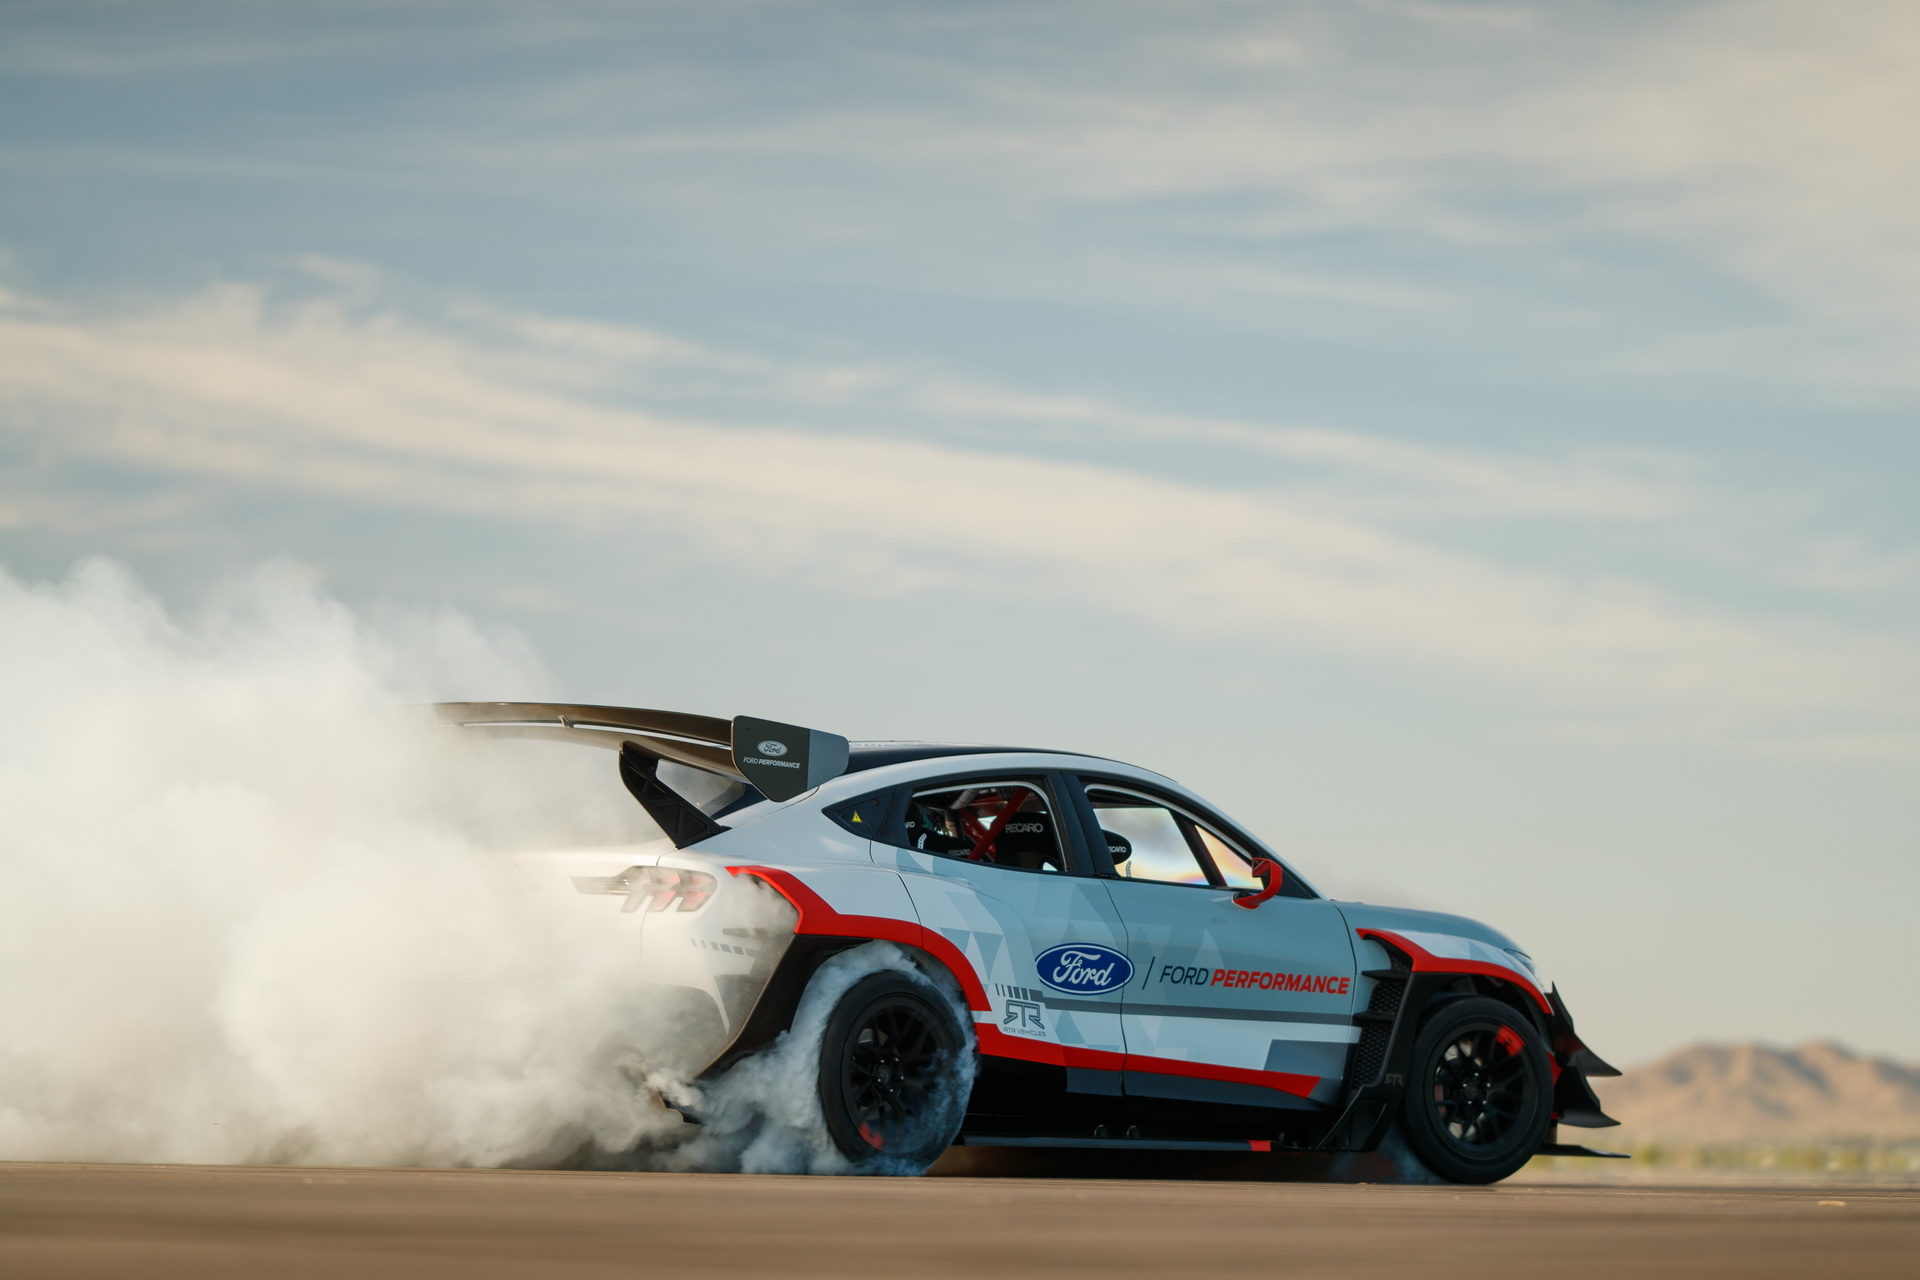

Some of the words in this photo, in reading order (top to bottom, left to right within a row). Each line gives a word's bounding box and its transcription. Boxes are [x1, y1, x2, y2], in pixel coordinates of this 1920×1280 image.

[764, 742, 782, 754] Ford
[759, 759, 800, 769] PERFORMANCE
[1005, 822, 1044, 834] RECARO
[948, 848, 971, 857] RECARO
[1052, 950, 1115, 987] Ford
[1159, 965, 1209, 986] FORD
[1210, 968, 1350, 995] PERFORMANCE
[1003, 1026, 1017, 1034] RTR
[1017, 1028, 1047, 1037] VEHICLES
